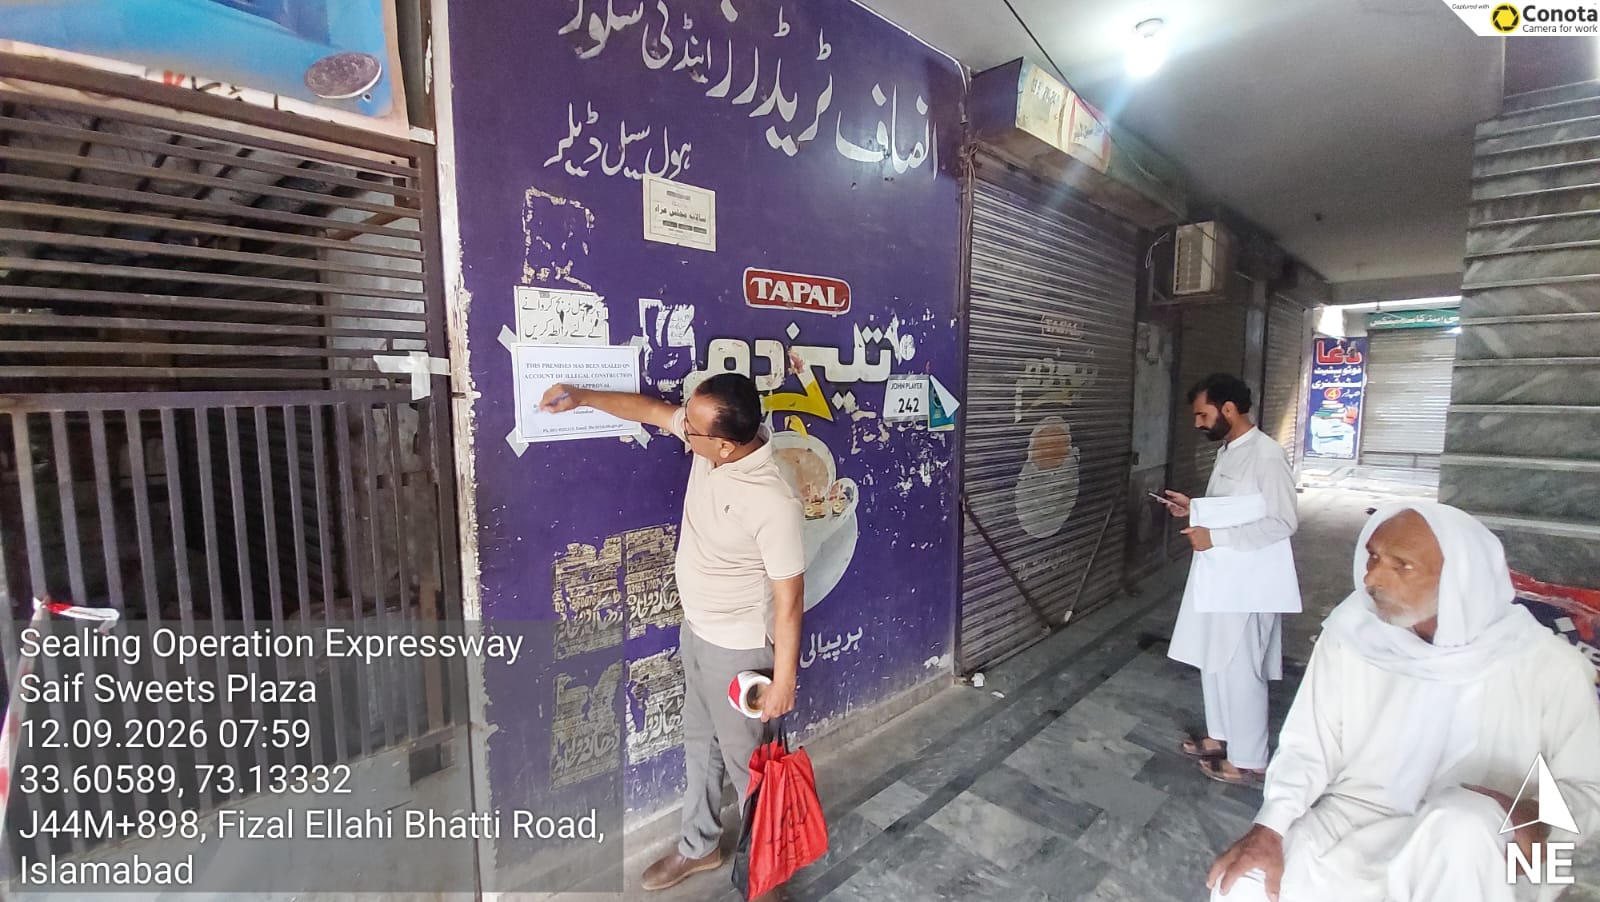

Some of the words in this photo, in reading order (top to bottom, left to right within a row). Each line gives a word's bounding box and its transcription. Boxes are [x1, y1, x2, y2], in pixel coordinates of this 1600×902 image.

[601, 120, 651, 180] سیل
[644, 125, 692, 179] ہول
[835, 83, 939, 181] انصاف
[749, 276, 848, 308] TAPAL
[890, 382, 905, 390] JOHN
[905, 382, 923, 390] PLAYER
[898, 396, 920, 413] 242
